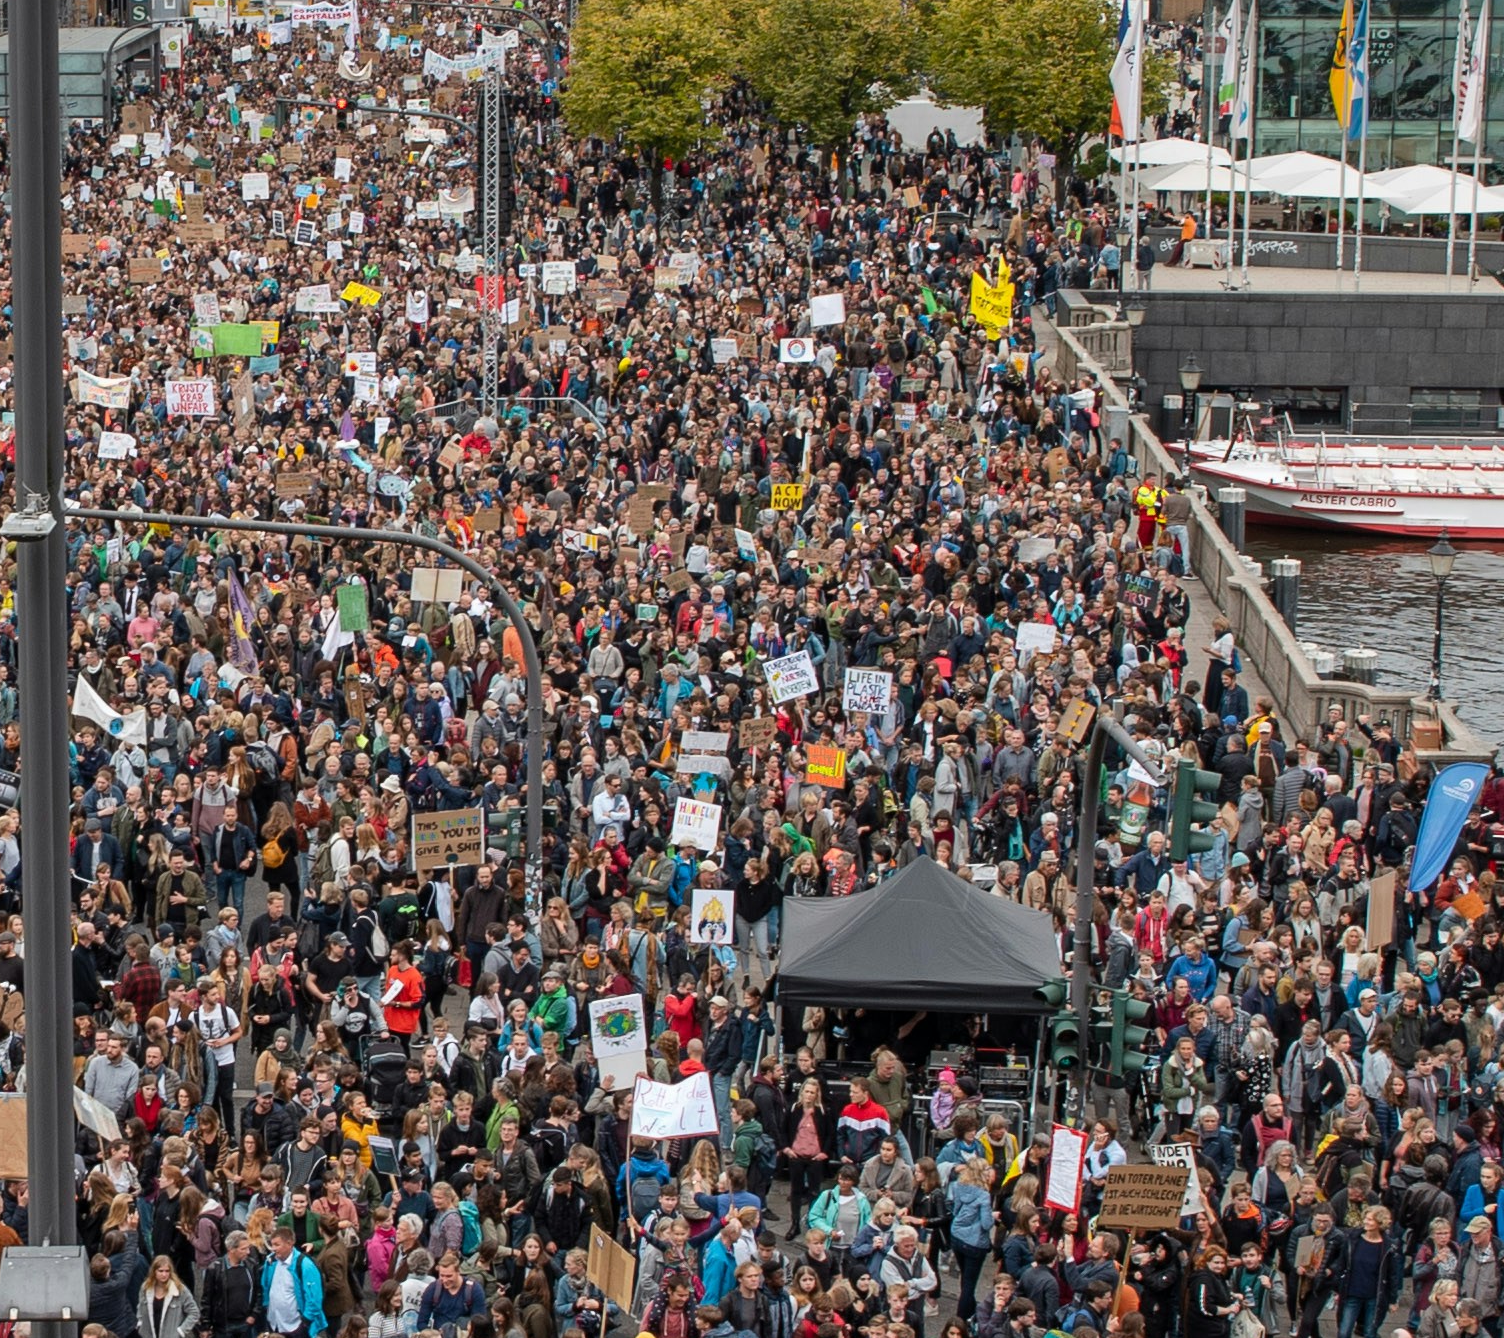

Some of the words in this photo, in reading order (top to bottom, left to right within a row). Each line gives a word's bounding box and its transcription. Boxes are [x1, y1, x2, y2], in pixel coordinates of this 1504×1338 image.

[133, 6, 147, 22] S
[293, 12, 352, 21] CAPITALISM
[172, 383, 208, 394] KRUSTY
[172, 402, 209, 413] UNFAIR
[774, 485, 800, 496] ACT
[773, 497, 801, 508] NOW
[1300, 493, 1348, 504] ALSTER
[1350, 495, 1397, 507] CABRIO
[1123, 592, 1152, 608] FIRST
[849, 670, 874, 683] LIFE
[875, 674, 886, 684] IN
[415, 845, 442, 857] GIVE
[1108, 1175, 1126, 1184] EIN
[1126, 1175, 1150, 1186] TOTER
[1150, 1174, 1189, 1187] PLANET
[1119, 1190, 1140, 1201] AUCH
[1140, 1189, 1183, 1202] SCHLECHT
[1129, 1205, 1181, 1219] WIRTSCHAFT
